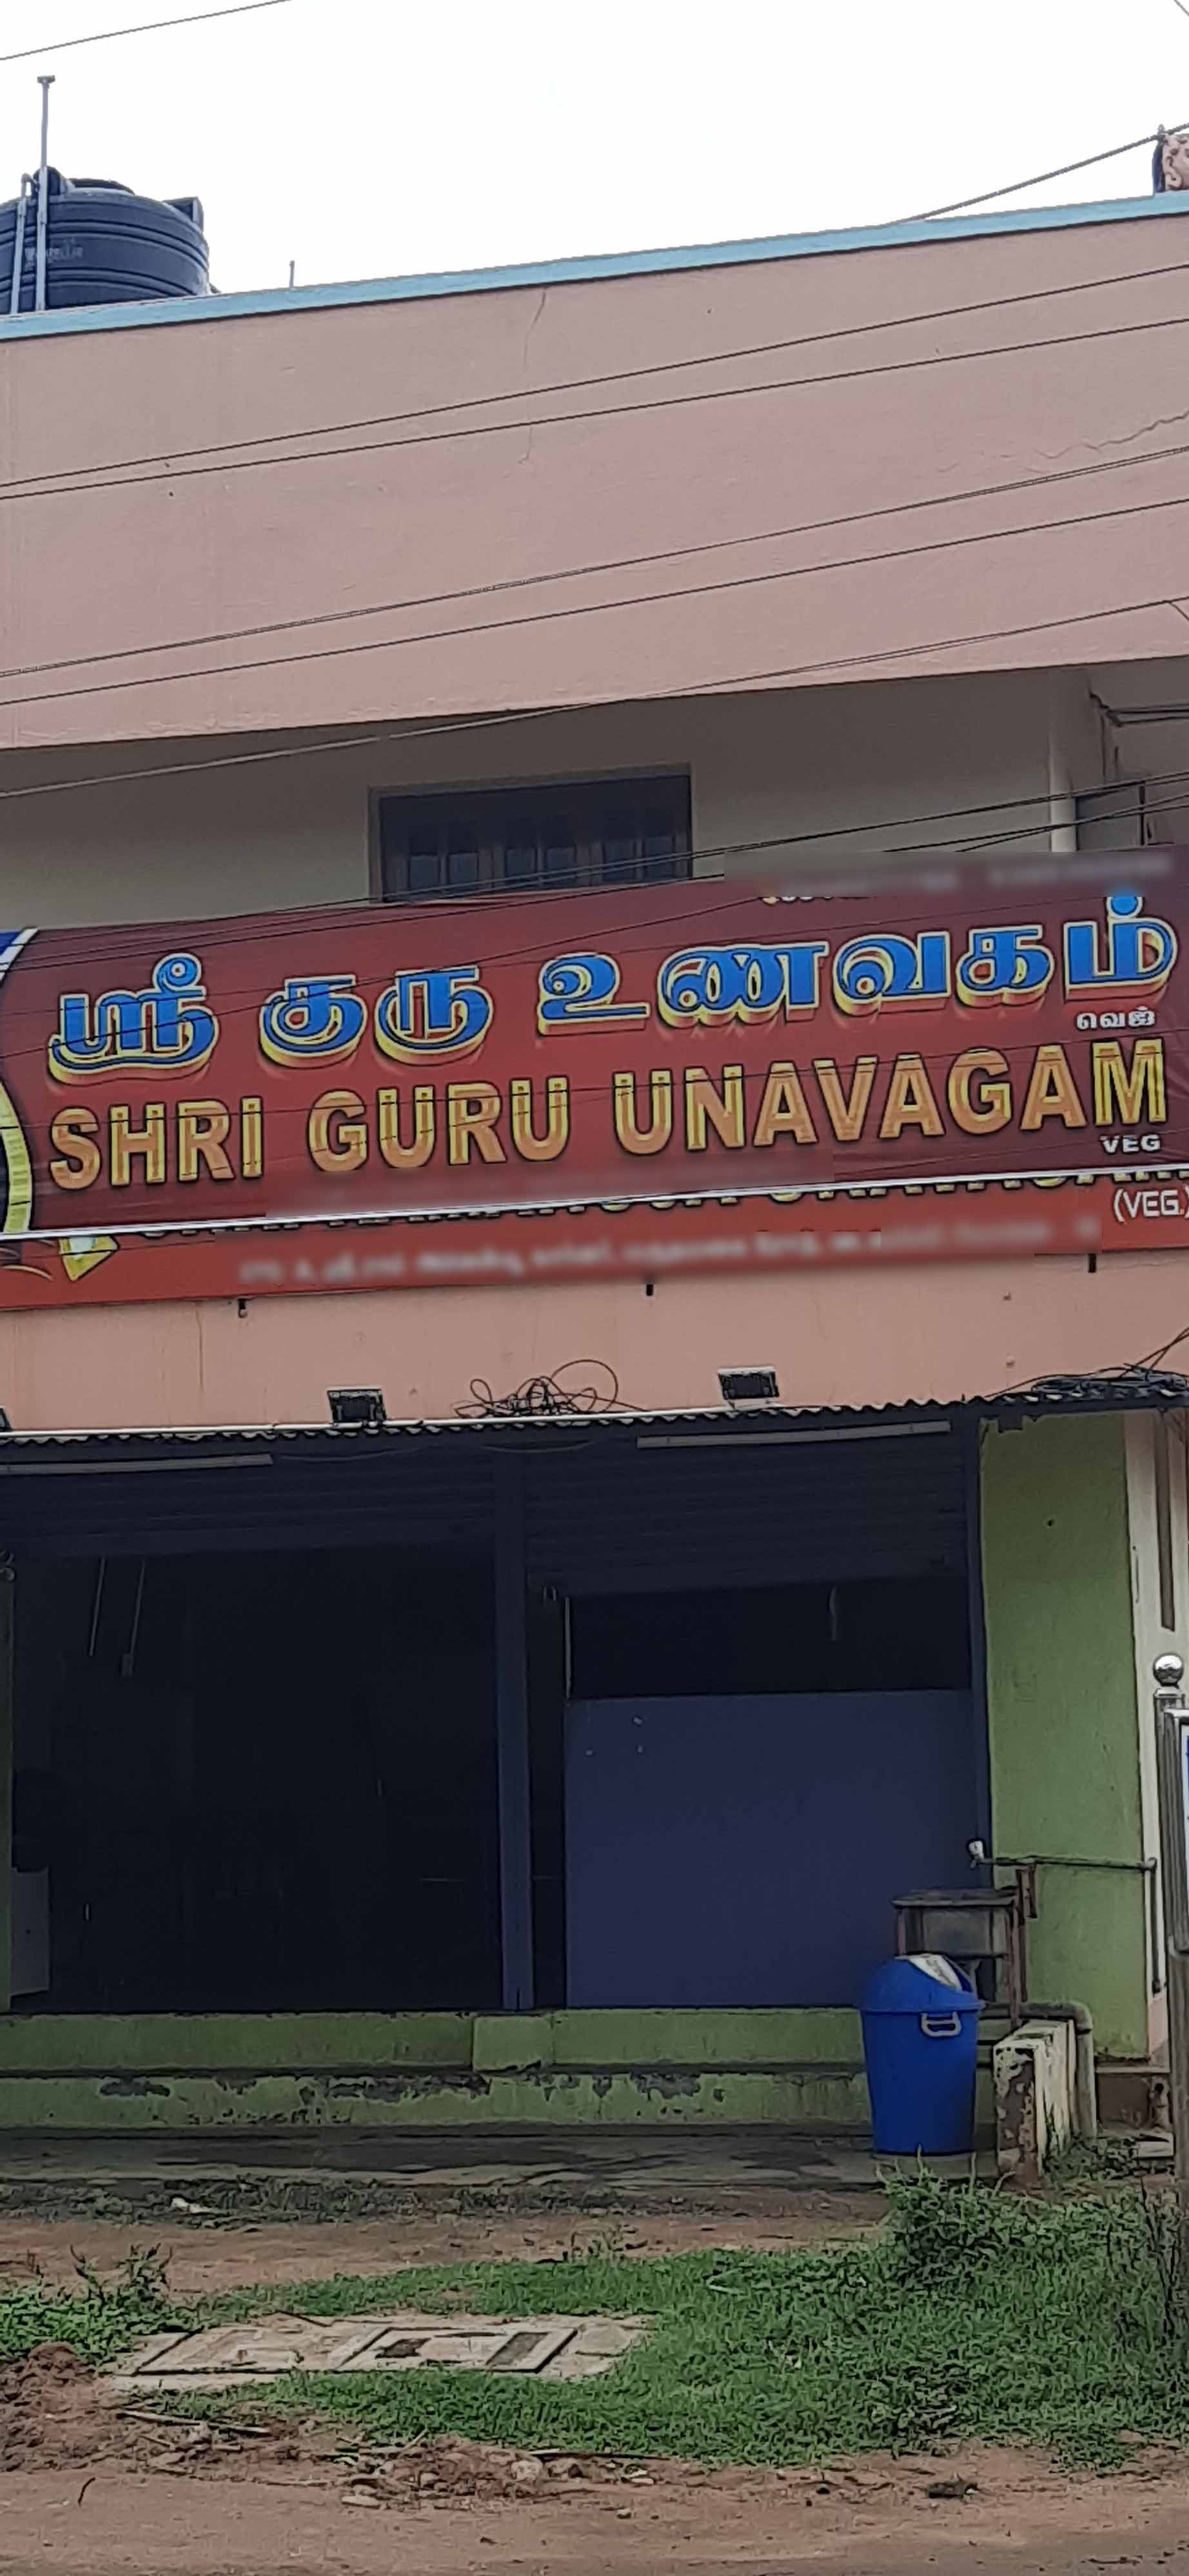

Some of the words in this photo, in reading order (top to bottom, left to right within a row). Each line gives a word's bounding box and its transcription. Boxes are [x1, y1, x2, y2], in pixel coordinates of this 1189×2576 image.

[259, 963, 495, 1068] குரு
[536, 889, 1177, 1033] உணவகம்
[48, 1096, 264, 1191] SHRI
[306, 1076, 571, 1173] GURU
[613, 1037, 1167, 1156] UNAVAGAM
[1099, 1134, 1161, 1154] VEG
